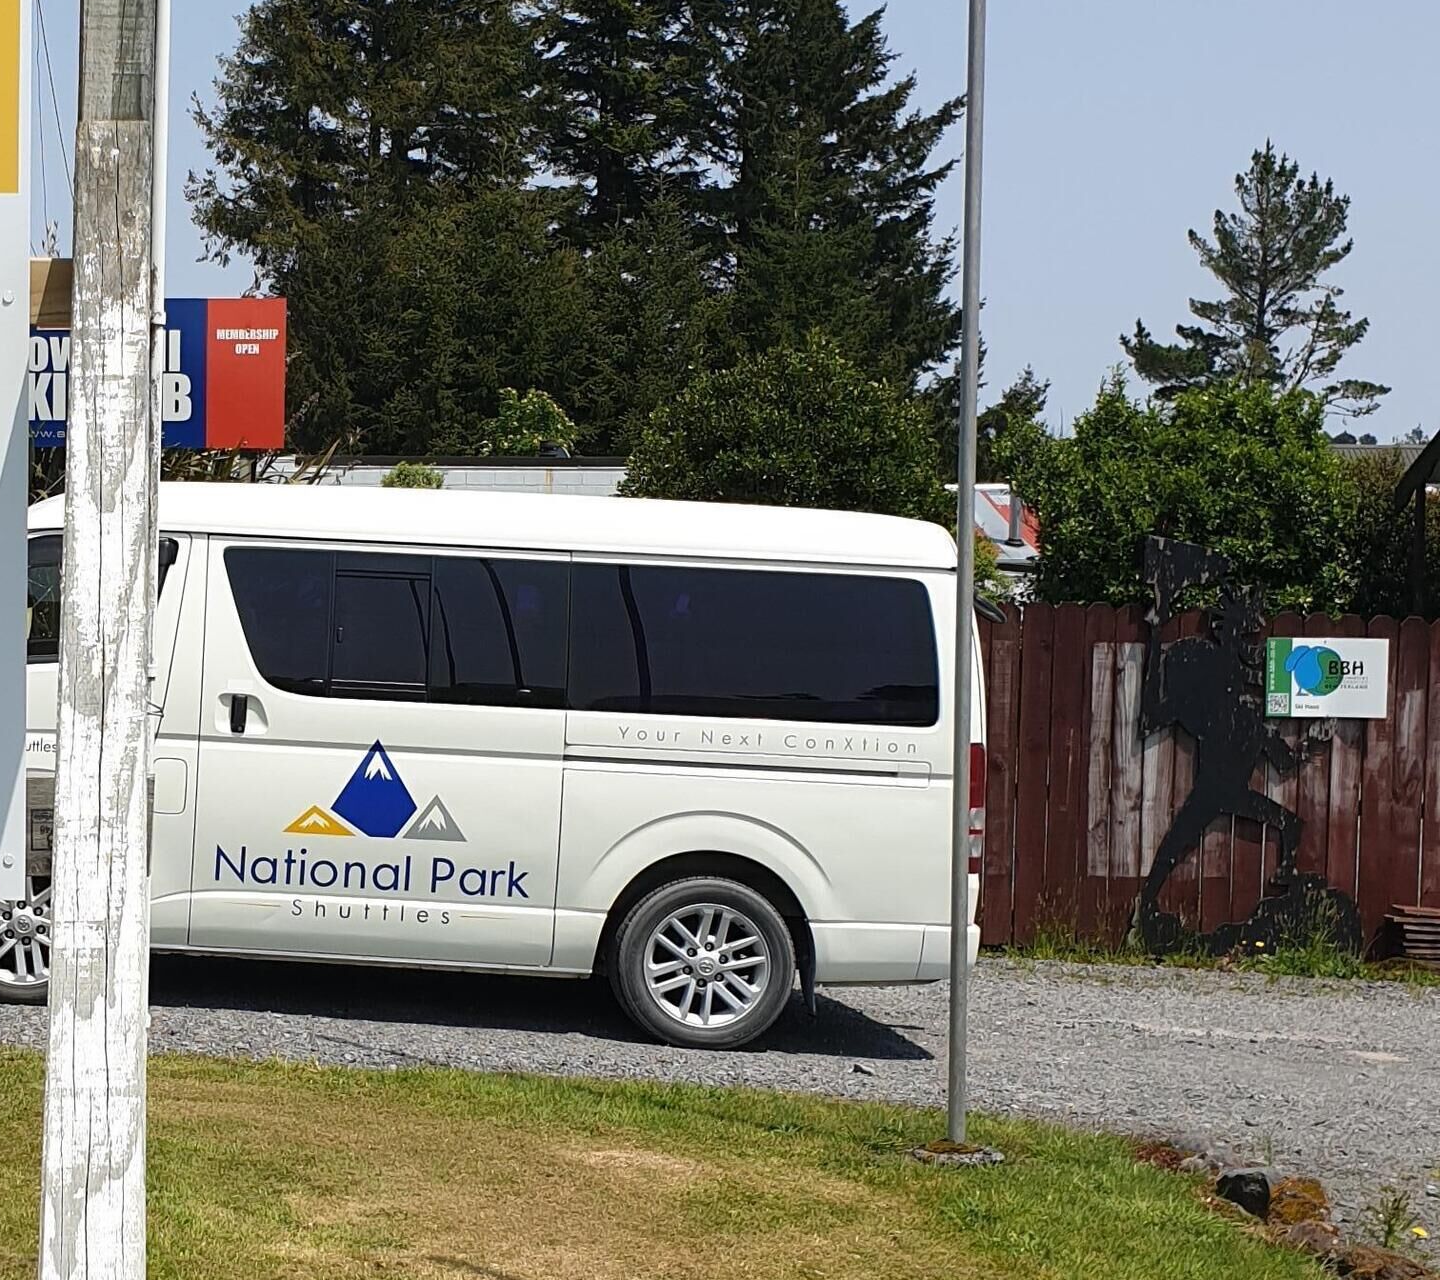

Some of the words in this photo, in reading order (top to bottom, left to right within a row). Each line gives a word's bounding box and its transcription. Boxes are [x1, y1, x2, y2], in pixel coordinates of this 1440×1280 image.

[216, 328, 279, 340] MEMBERSHIP
[235, 343, 260, 355] OPEN
[1328, 660, 1364, 676] BBH
[618, 726, 681, 743] Your
[701, 730, 762, 747] Next
[783, 734, 918, 754] ConXtion
[214, 844, 411, 892] National
[430, 857, 530, 899] Park
[291, 898, 450, 925] Shuttles
